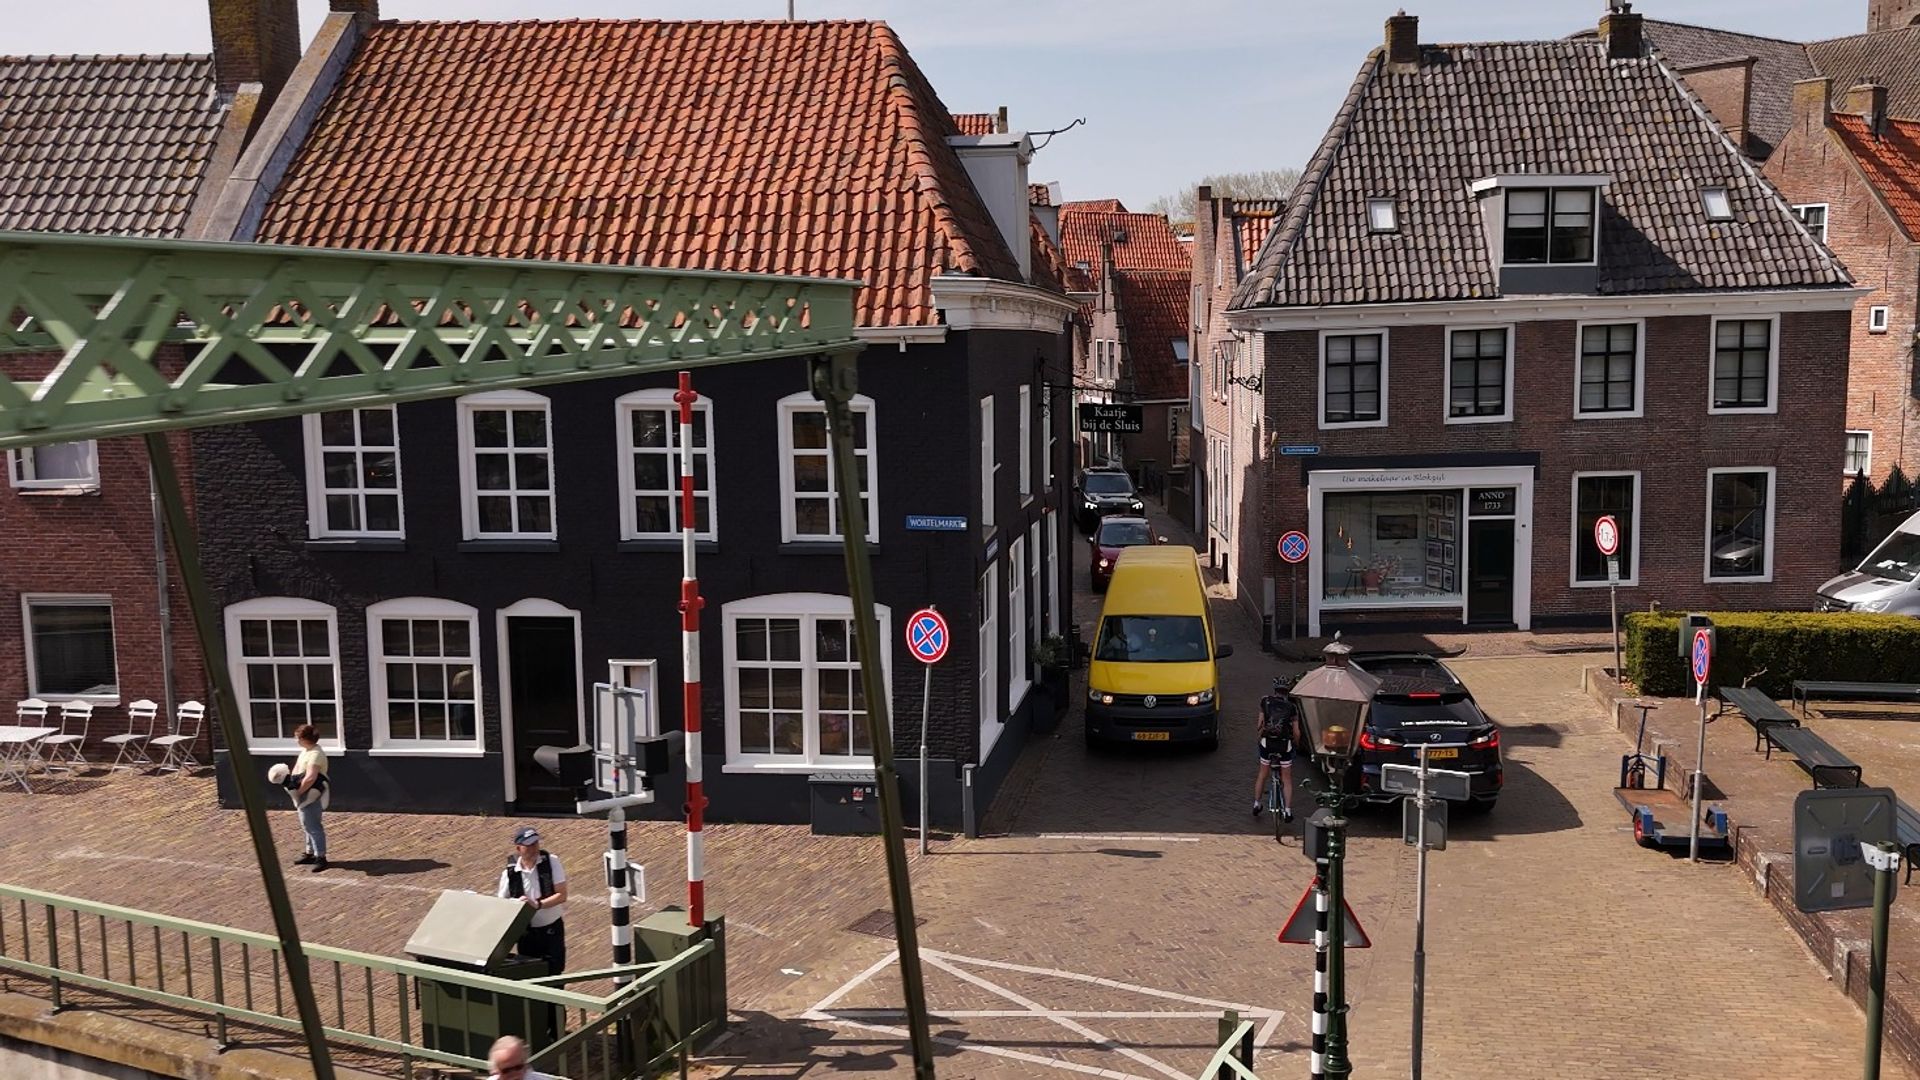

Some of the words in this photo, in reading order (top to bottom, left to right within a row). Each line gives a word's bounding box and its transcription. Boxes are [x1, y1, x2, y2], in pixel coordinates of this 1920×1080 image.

[1094, 406, 1127, 419] Kaatje
[1082, 419, 1097, 431] bij
[1099, 419, 1112, 430] de
[1114, 420, 1140, 430] Sluis
[1478, 491, 1505, 500] ANNO
[1484, 501, 1501, 510] 1733
[909, 518, 963, 528] WORTELMARKT
